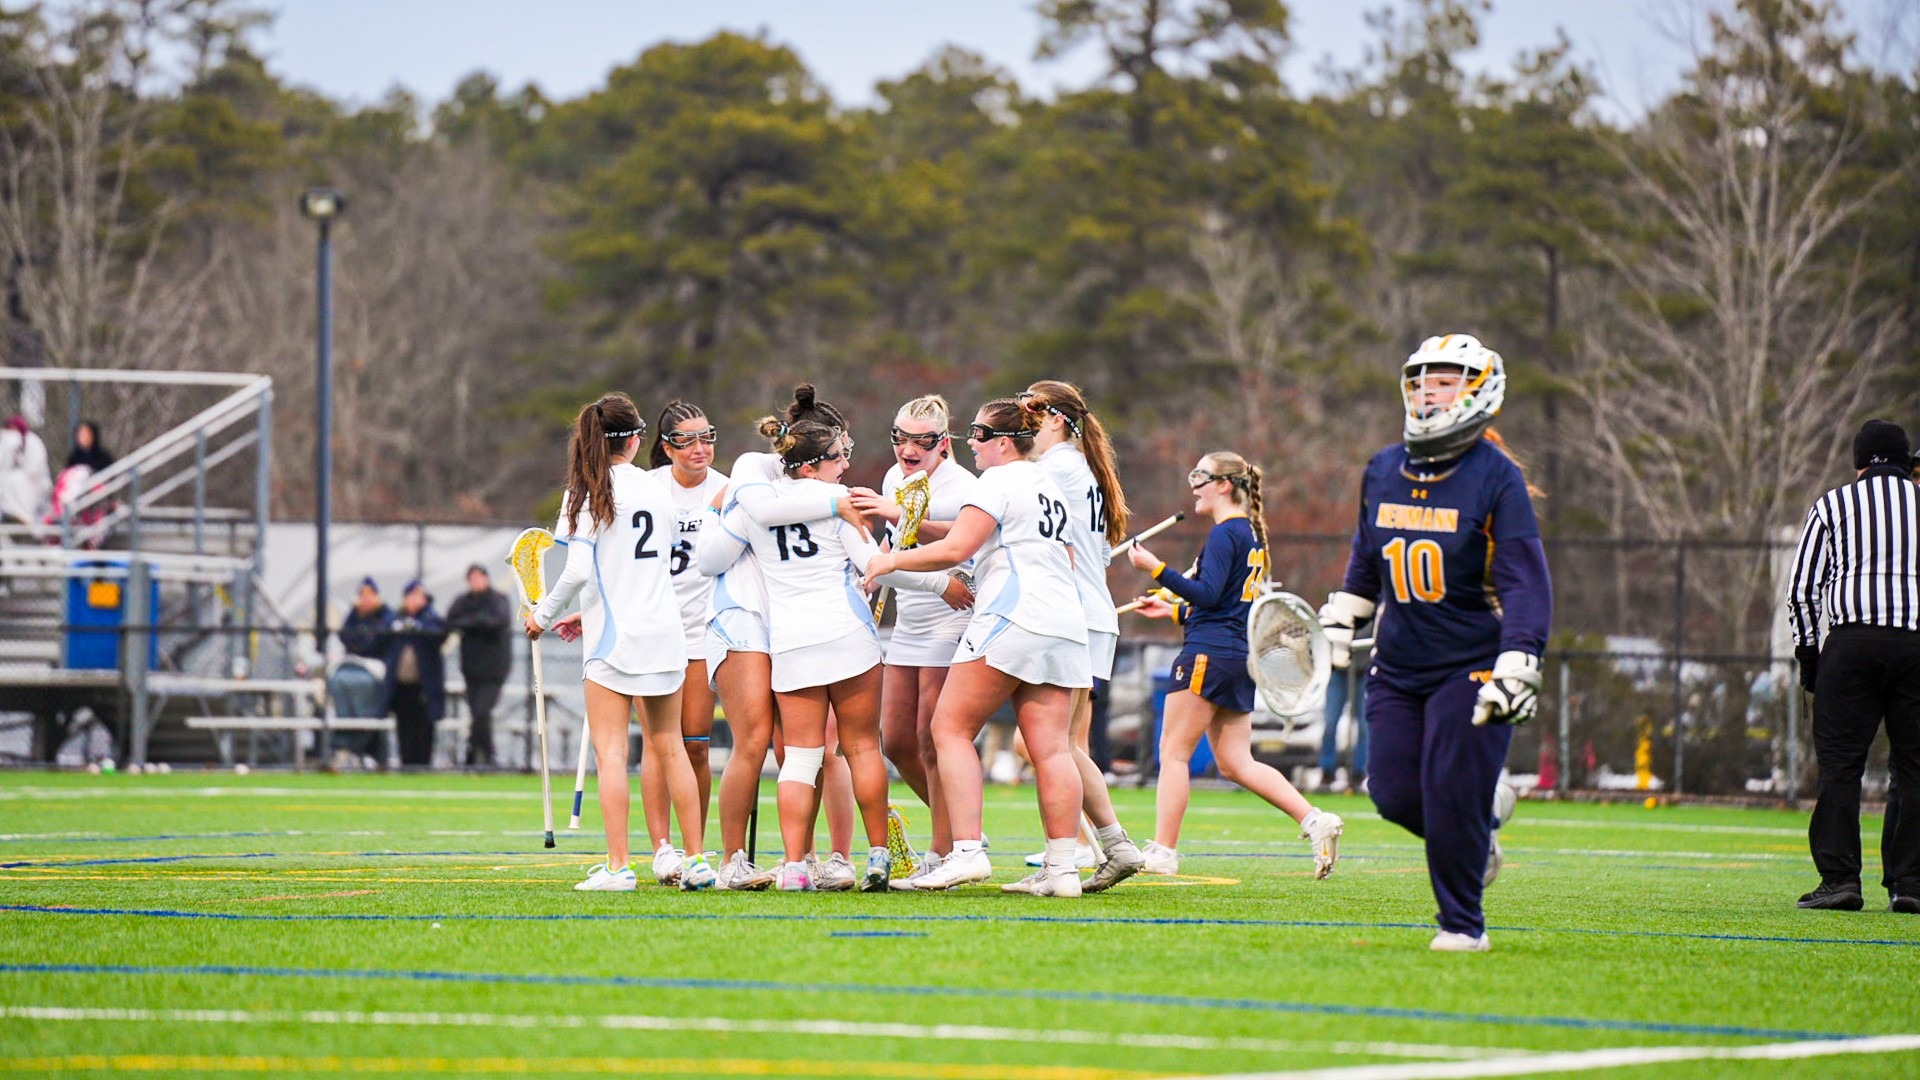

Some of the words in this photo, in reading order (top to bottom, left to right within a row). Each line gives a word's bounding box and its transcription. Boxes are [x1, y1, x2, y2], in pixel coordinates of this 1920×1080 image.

[1038, 493, 1067, 546] 32
[1086, 485, 1105, 533] 12
[1375, 502, 1459, 533] NEUMANN
[632, 510, 658, 559] 2
[670, 539, 693, 576] 6
[769, 522, 819, 561] 13
[1382, 536, 1446, 603] 10
